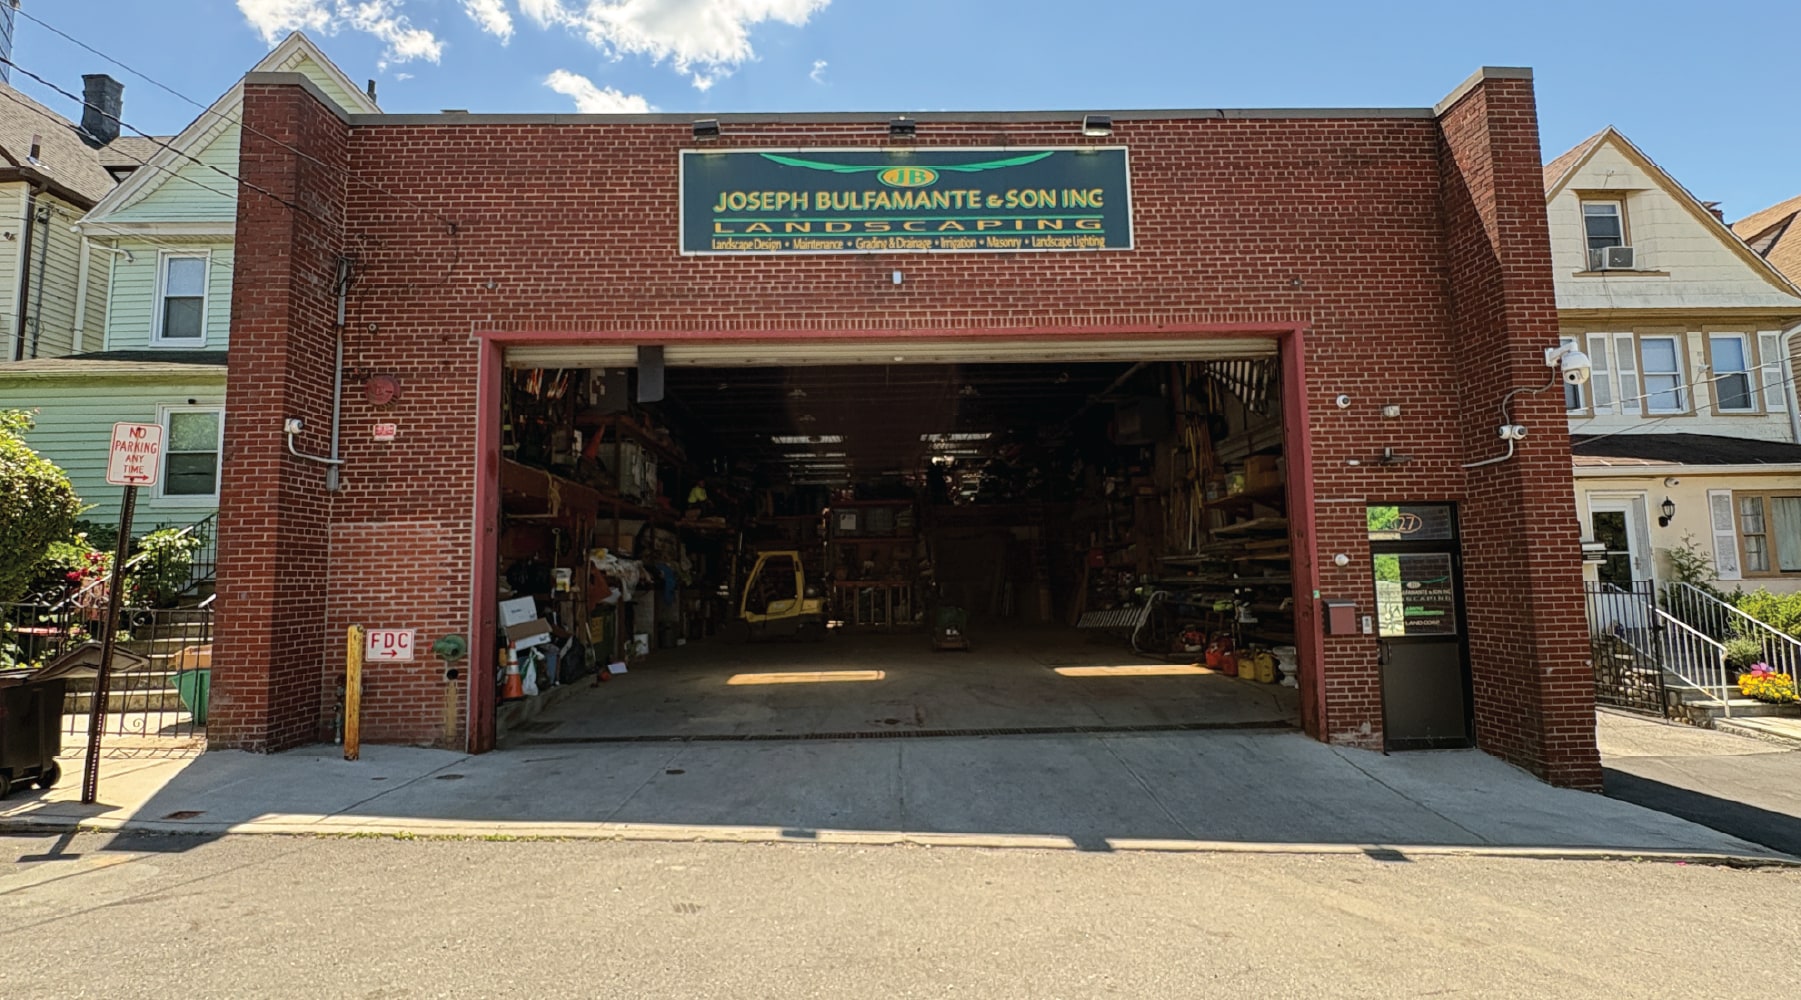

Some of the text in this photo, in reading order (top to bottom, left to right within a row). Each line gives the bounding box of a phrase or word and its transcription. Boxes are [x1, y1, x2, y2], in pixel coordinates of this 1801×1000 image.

[889, 169, 927, 185] JB
[713, 188, 1104, 212] JOSEPH BULFAMANTE & SON INC
[714, 219, 1102, 233] LANDSCAPING
[712, 237, 754, 252] Landscape
[754, 237, 782, 252] Design
[793, 237, 843, 250] Maintenance
[856, 236, 888, 250] Grading
[896, 236, 932, 250] Drainage
[941, 236, 977, 249] Irrigation
[986, 236, 1022, 249] Masonry
[1031, 235, 1072, 249] Landscape
[1072, 235, 1105, 249] Lighting
[129, 427, 147, 439] NO
[114, 440, 158, 454] PARKING
[125, 454, 144, 463] ANY
[123, 464, 144, 474] TIME
[371, 632, 408, 649] FDC
